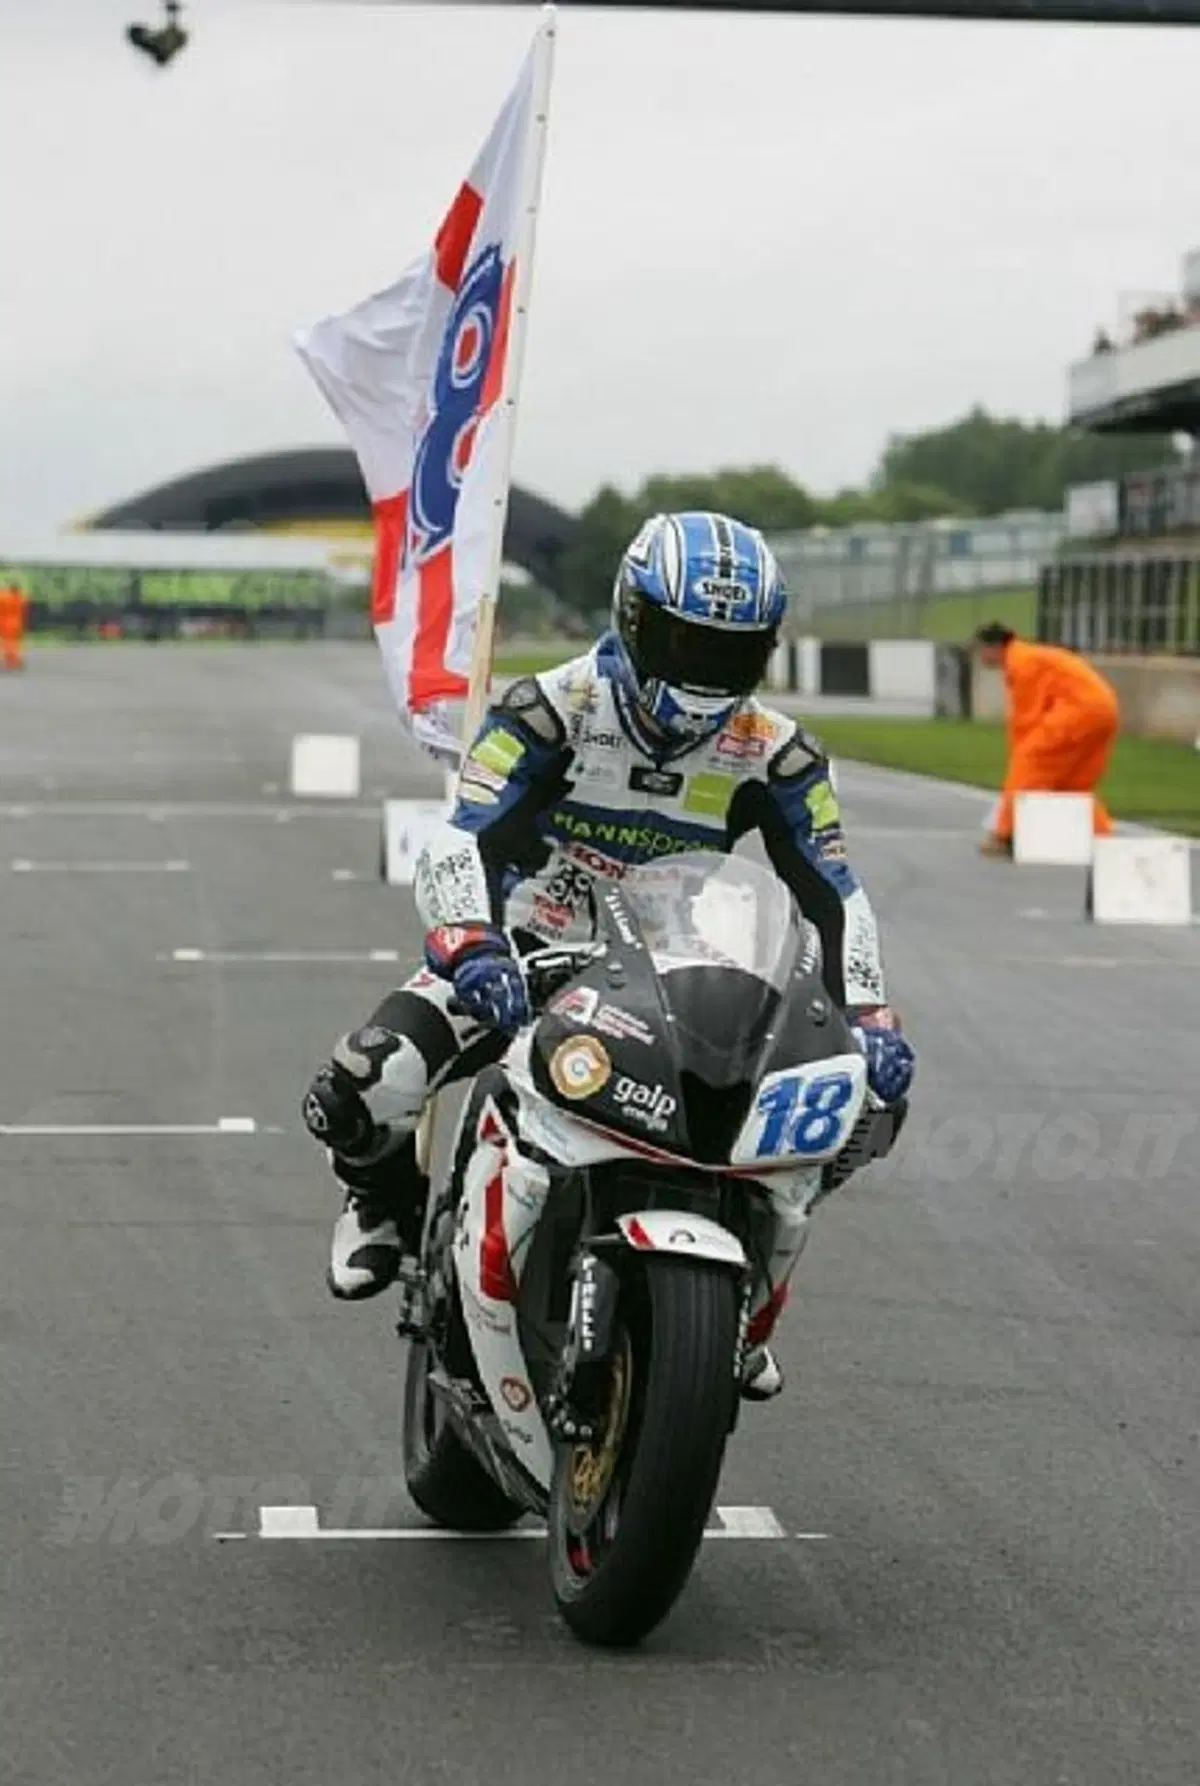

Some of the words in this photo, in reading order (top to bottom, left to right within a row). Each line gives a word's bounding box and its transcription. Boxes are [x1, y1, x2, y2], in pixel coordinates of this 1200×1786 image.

[702, 581, 747, 601] SHOEI
[613, 1076, 676, 1120] galp
[757, 1073, 853, 1156] 18
